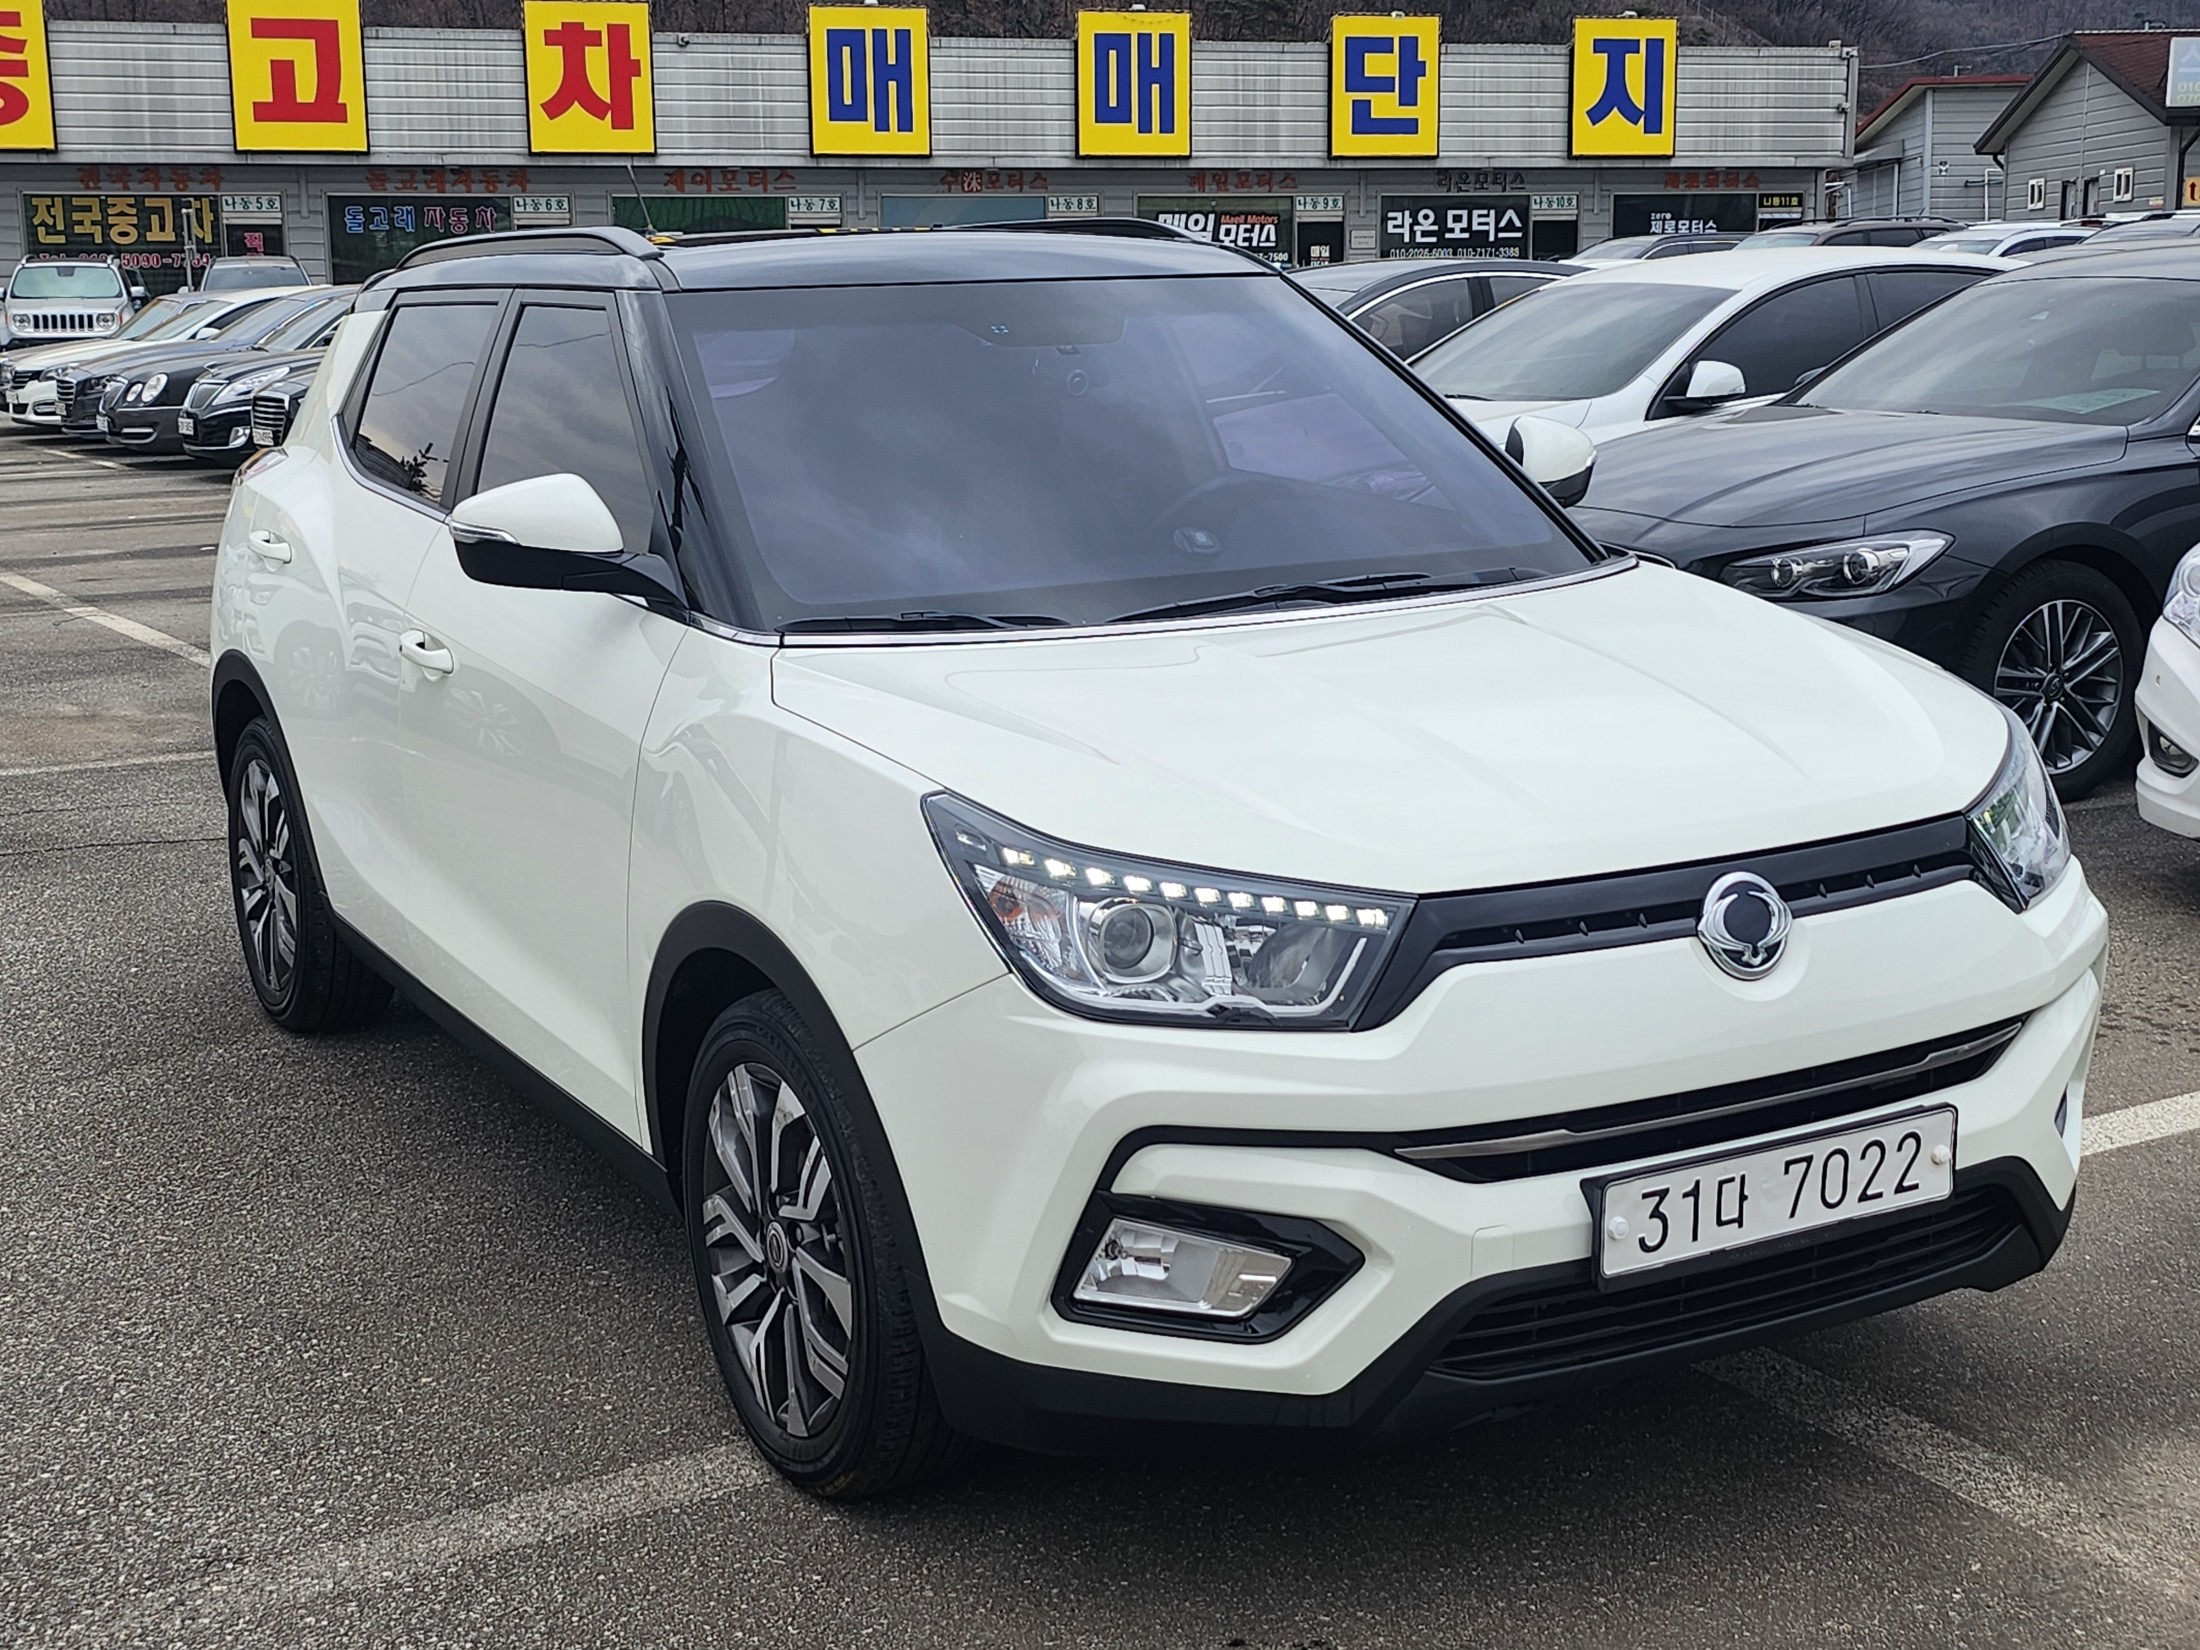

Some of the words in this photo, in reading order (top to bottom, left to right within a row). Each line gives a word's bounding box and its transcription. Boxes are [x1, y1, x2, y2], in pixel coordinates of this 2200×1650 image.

[663, 168, 797, 193] 제이모터스
[1437, 171, 1526, 193] 라온모터스
[31, 197, 214, 245] 전국중고차
[344, 206, 415, 233] 돌고래
[423, 206, 497, 234] 자동차
[1247, 214, 1279, 224] Motors
[1387, 209, 1438, 243] 라온
[1445, 209, 1523, 242] 모터스
[1650, 219, 1718, 234] 제로모터스
[1219, 224, 1277, 247] 모터스
[1638, 1173, 1748, 1253] 31다
[1783, 1131, 1922, 1219] 7022
